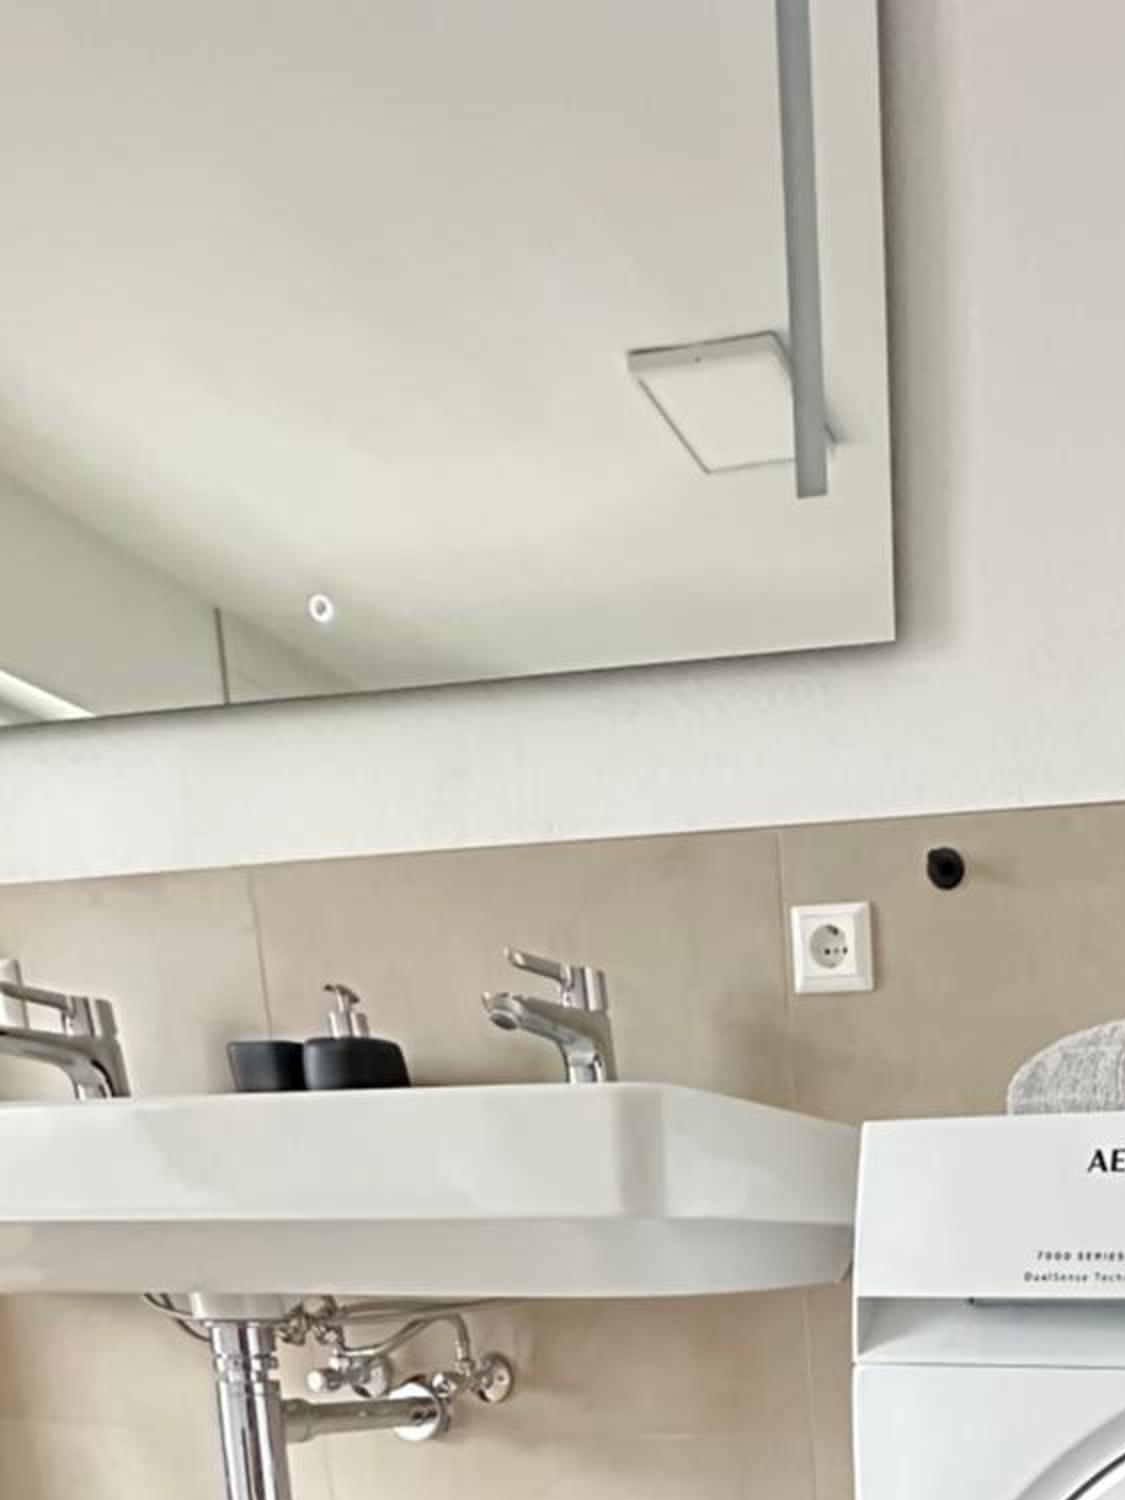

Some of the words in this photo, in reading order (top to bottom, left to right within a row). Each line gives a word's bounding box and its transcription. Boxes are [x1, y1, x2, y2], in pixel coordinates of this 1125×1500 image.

[1037, 1251, 1072, 1261] 7000
[1077, 1251, 1124, 1261] SERIES
[1024, 1271, 1089, 1283] DualSense
